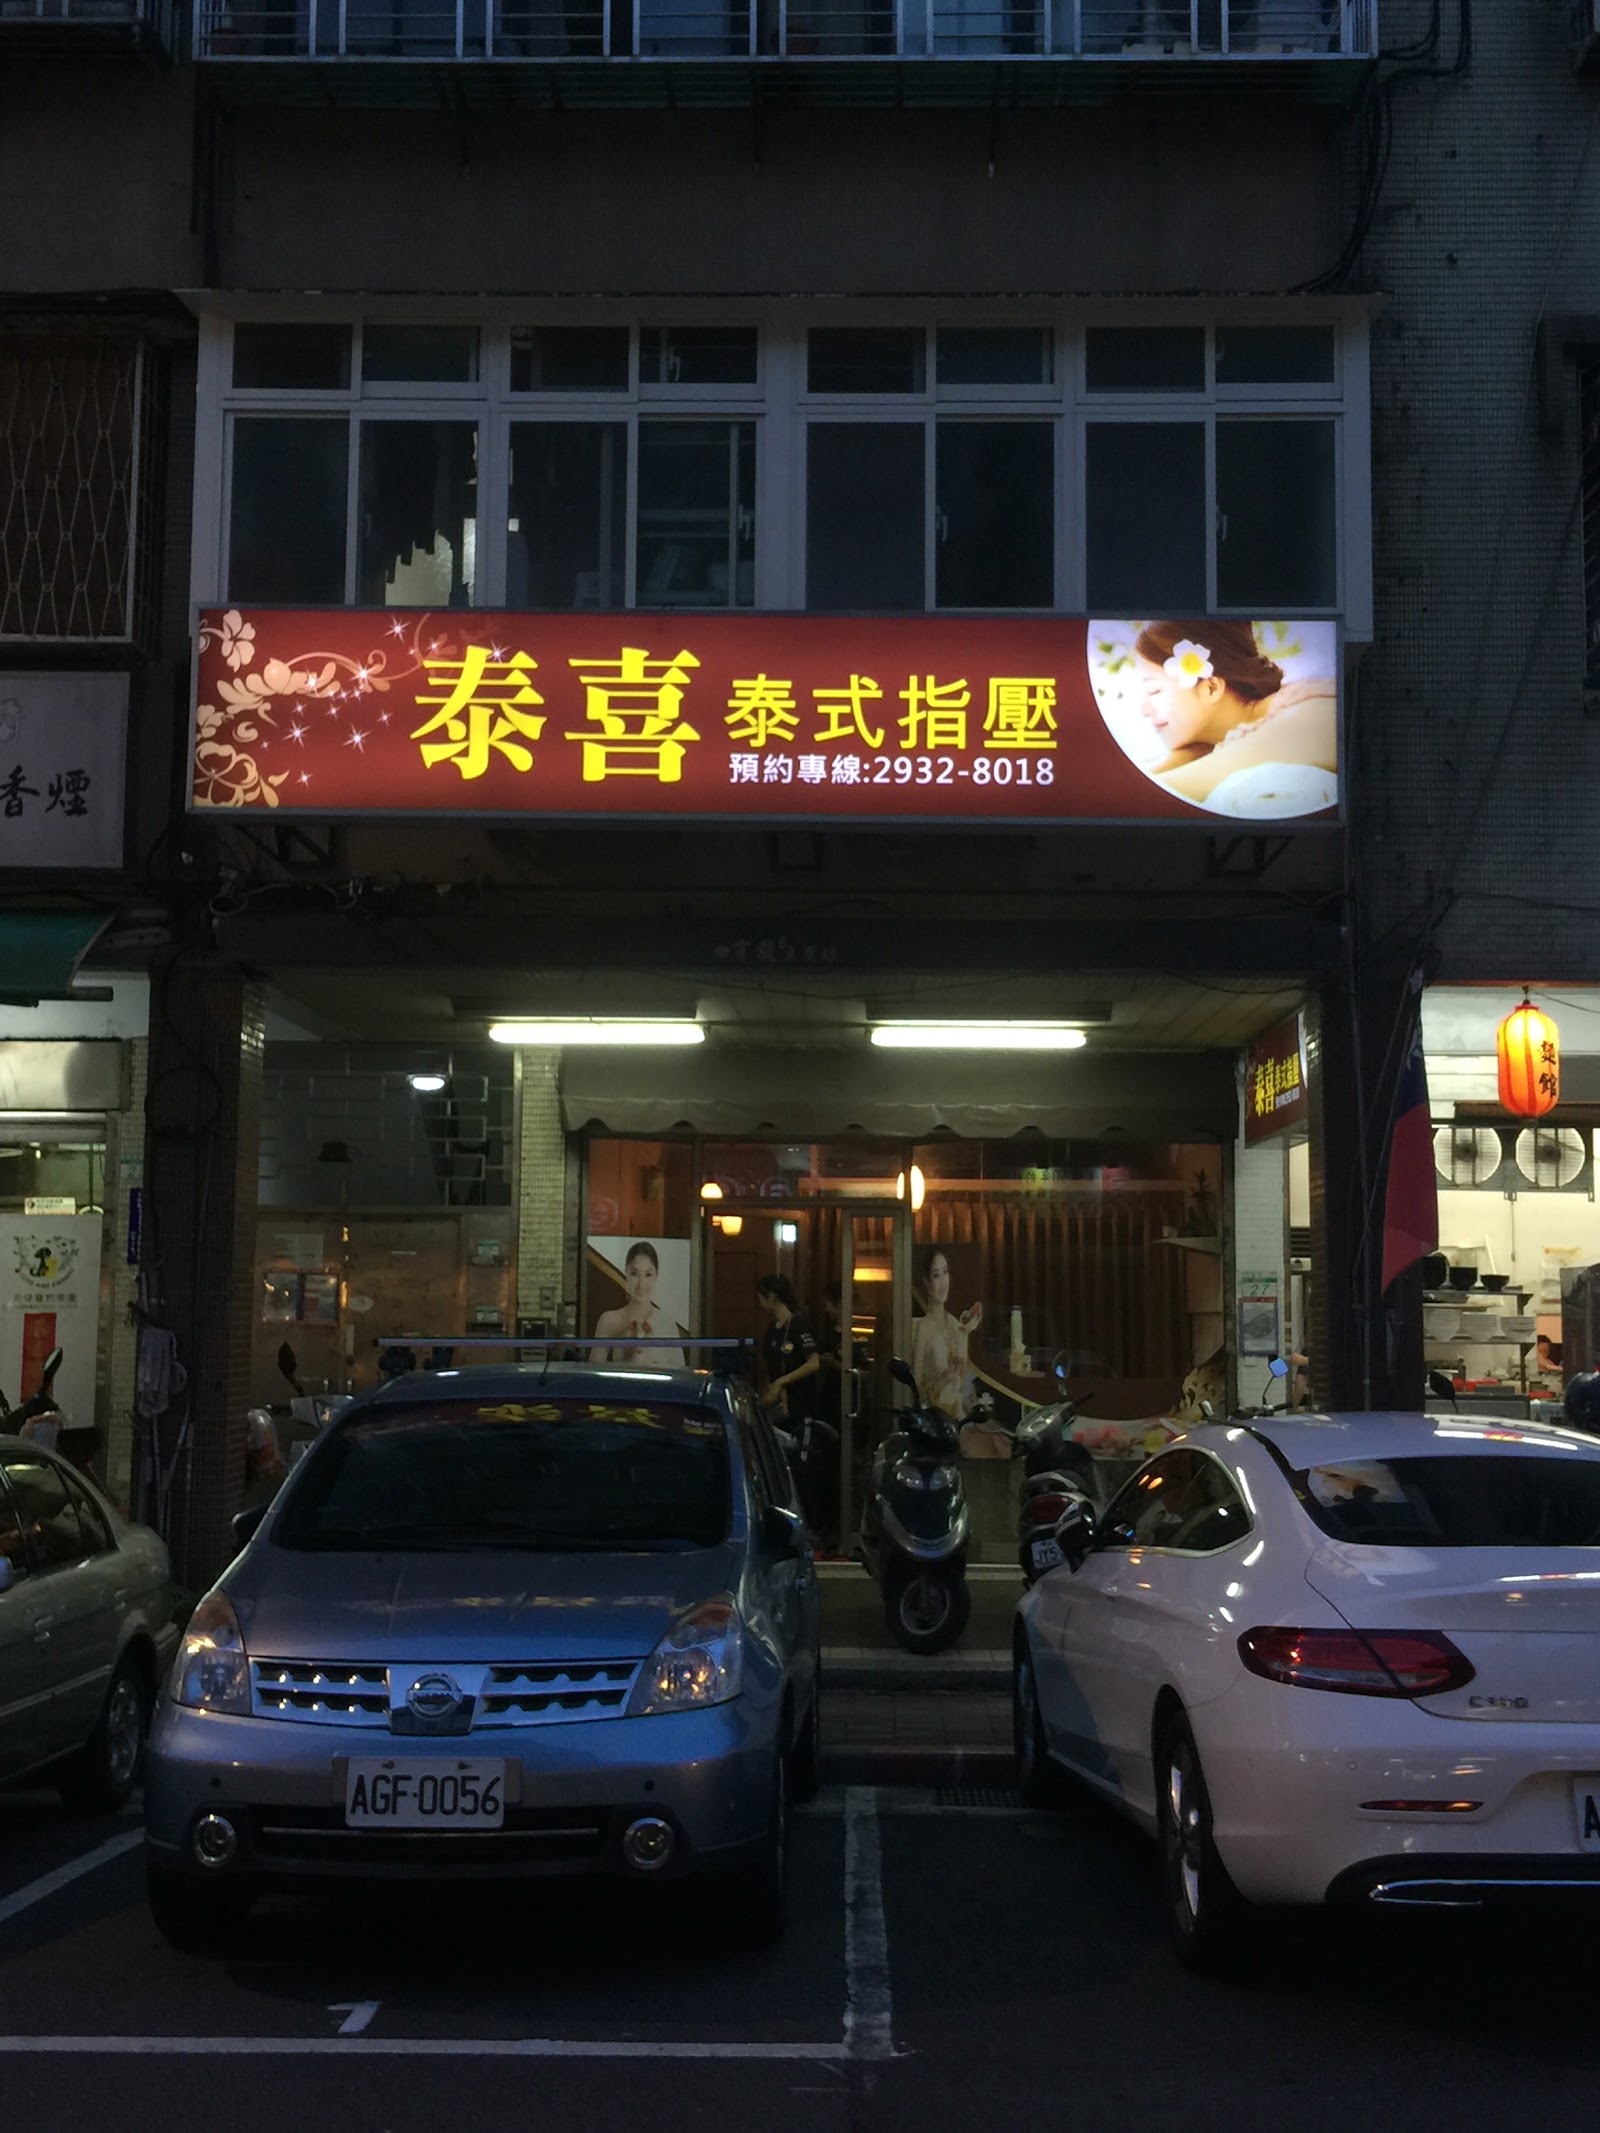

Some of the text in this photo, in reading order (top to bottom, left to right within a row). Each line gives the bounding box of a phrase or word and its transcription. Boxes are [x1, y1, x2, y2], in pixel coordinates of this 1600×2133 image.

[410, 645, 700, 783] 泰喜
[724, 673, 1058, 750] 泰式指壓
